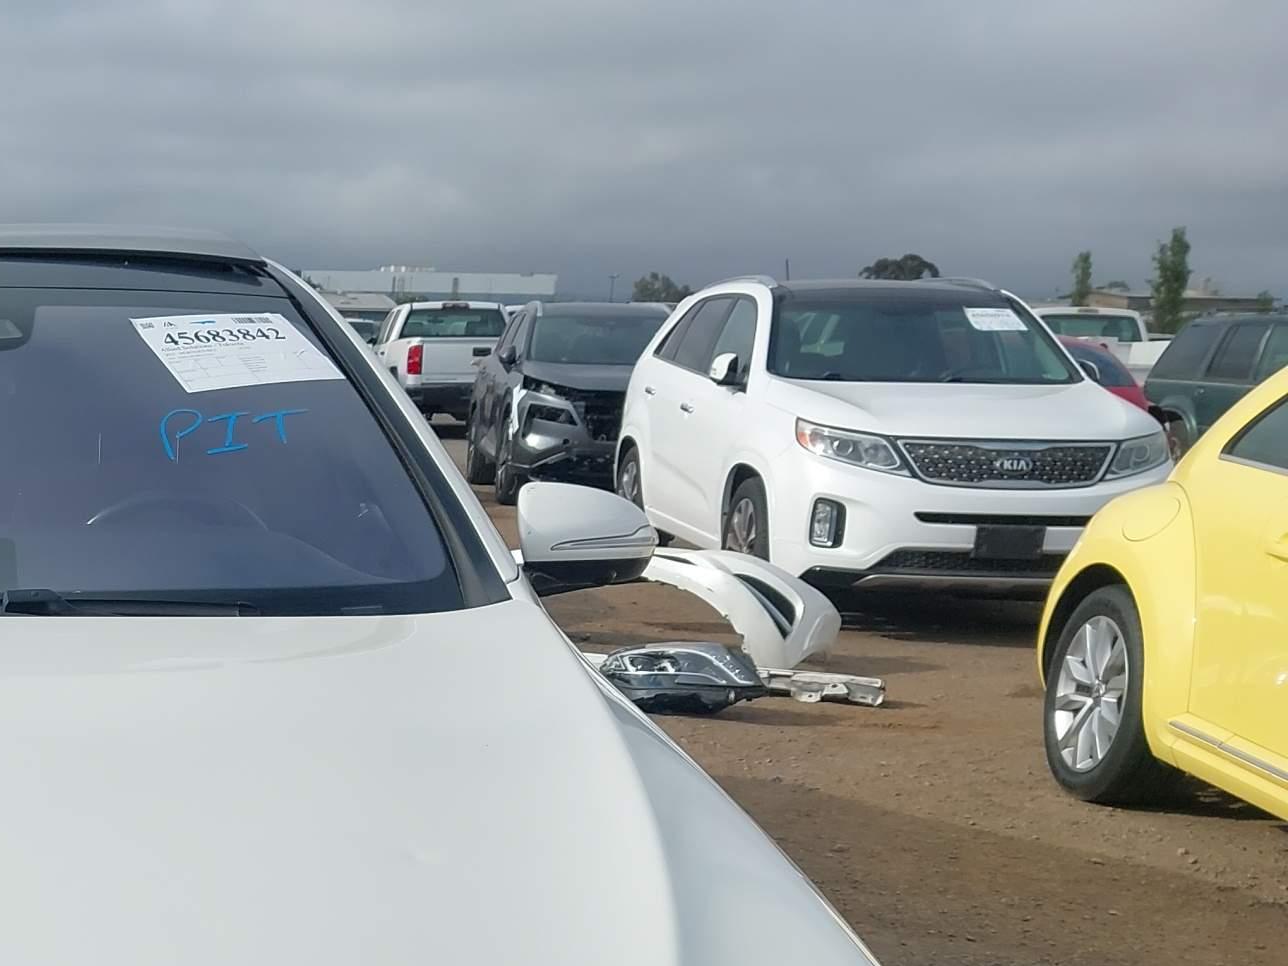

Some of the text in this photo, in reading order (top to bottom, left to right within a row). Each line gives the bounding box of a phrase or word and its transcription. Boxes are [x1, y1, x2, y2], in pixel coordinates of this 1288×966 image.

[164, 327, 286, 346] 45683842
[160, 408, 310, 462] PIT
[1003, 459, 1027, 470] KIA
